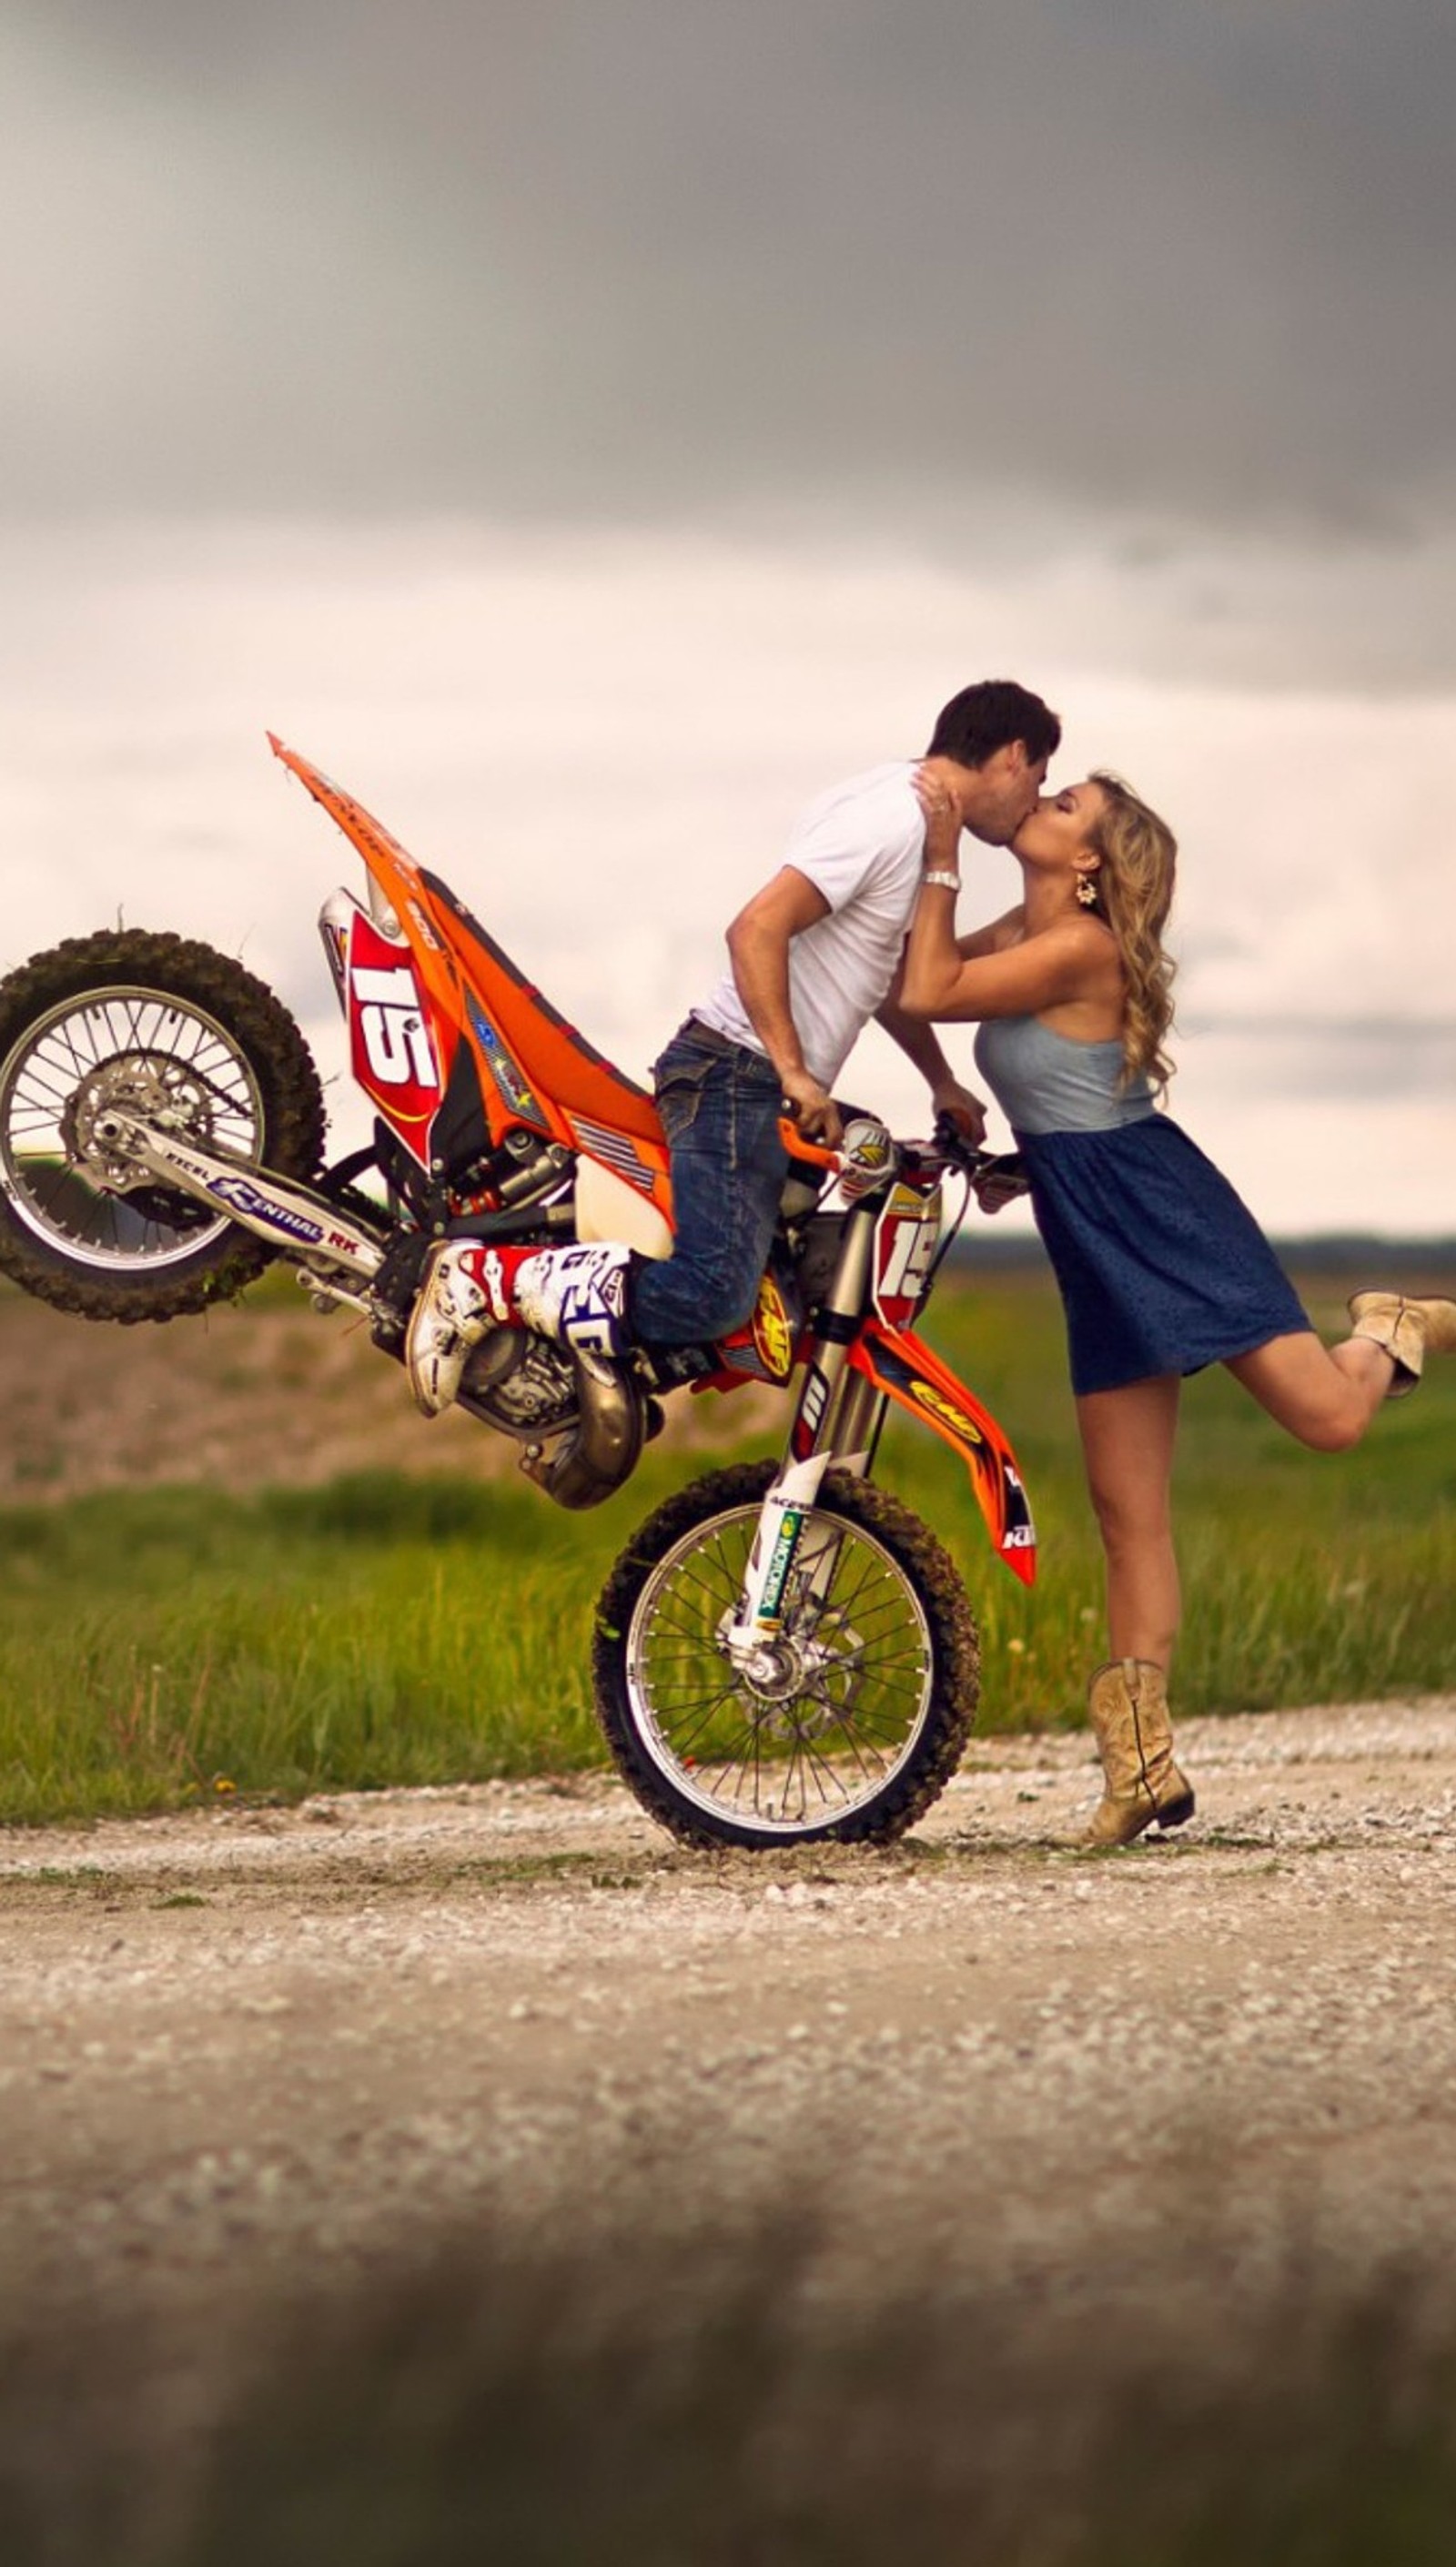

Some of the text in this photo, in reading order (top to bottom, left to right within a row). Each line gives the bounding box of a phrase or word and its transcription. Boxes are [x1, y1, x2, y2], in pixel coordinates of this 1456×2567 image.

[352, 967, 438, 1087] 15
[166, 1152, 210, 1180] EXCEL
[328, 1231, 359, 1255] RK
[879, 1221, 938, 1298] 15
[761, 1538, 792, 1609] MOTOREX
